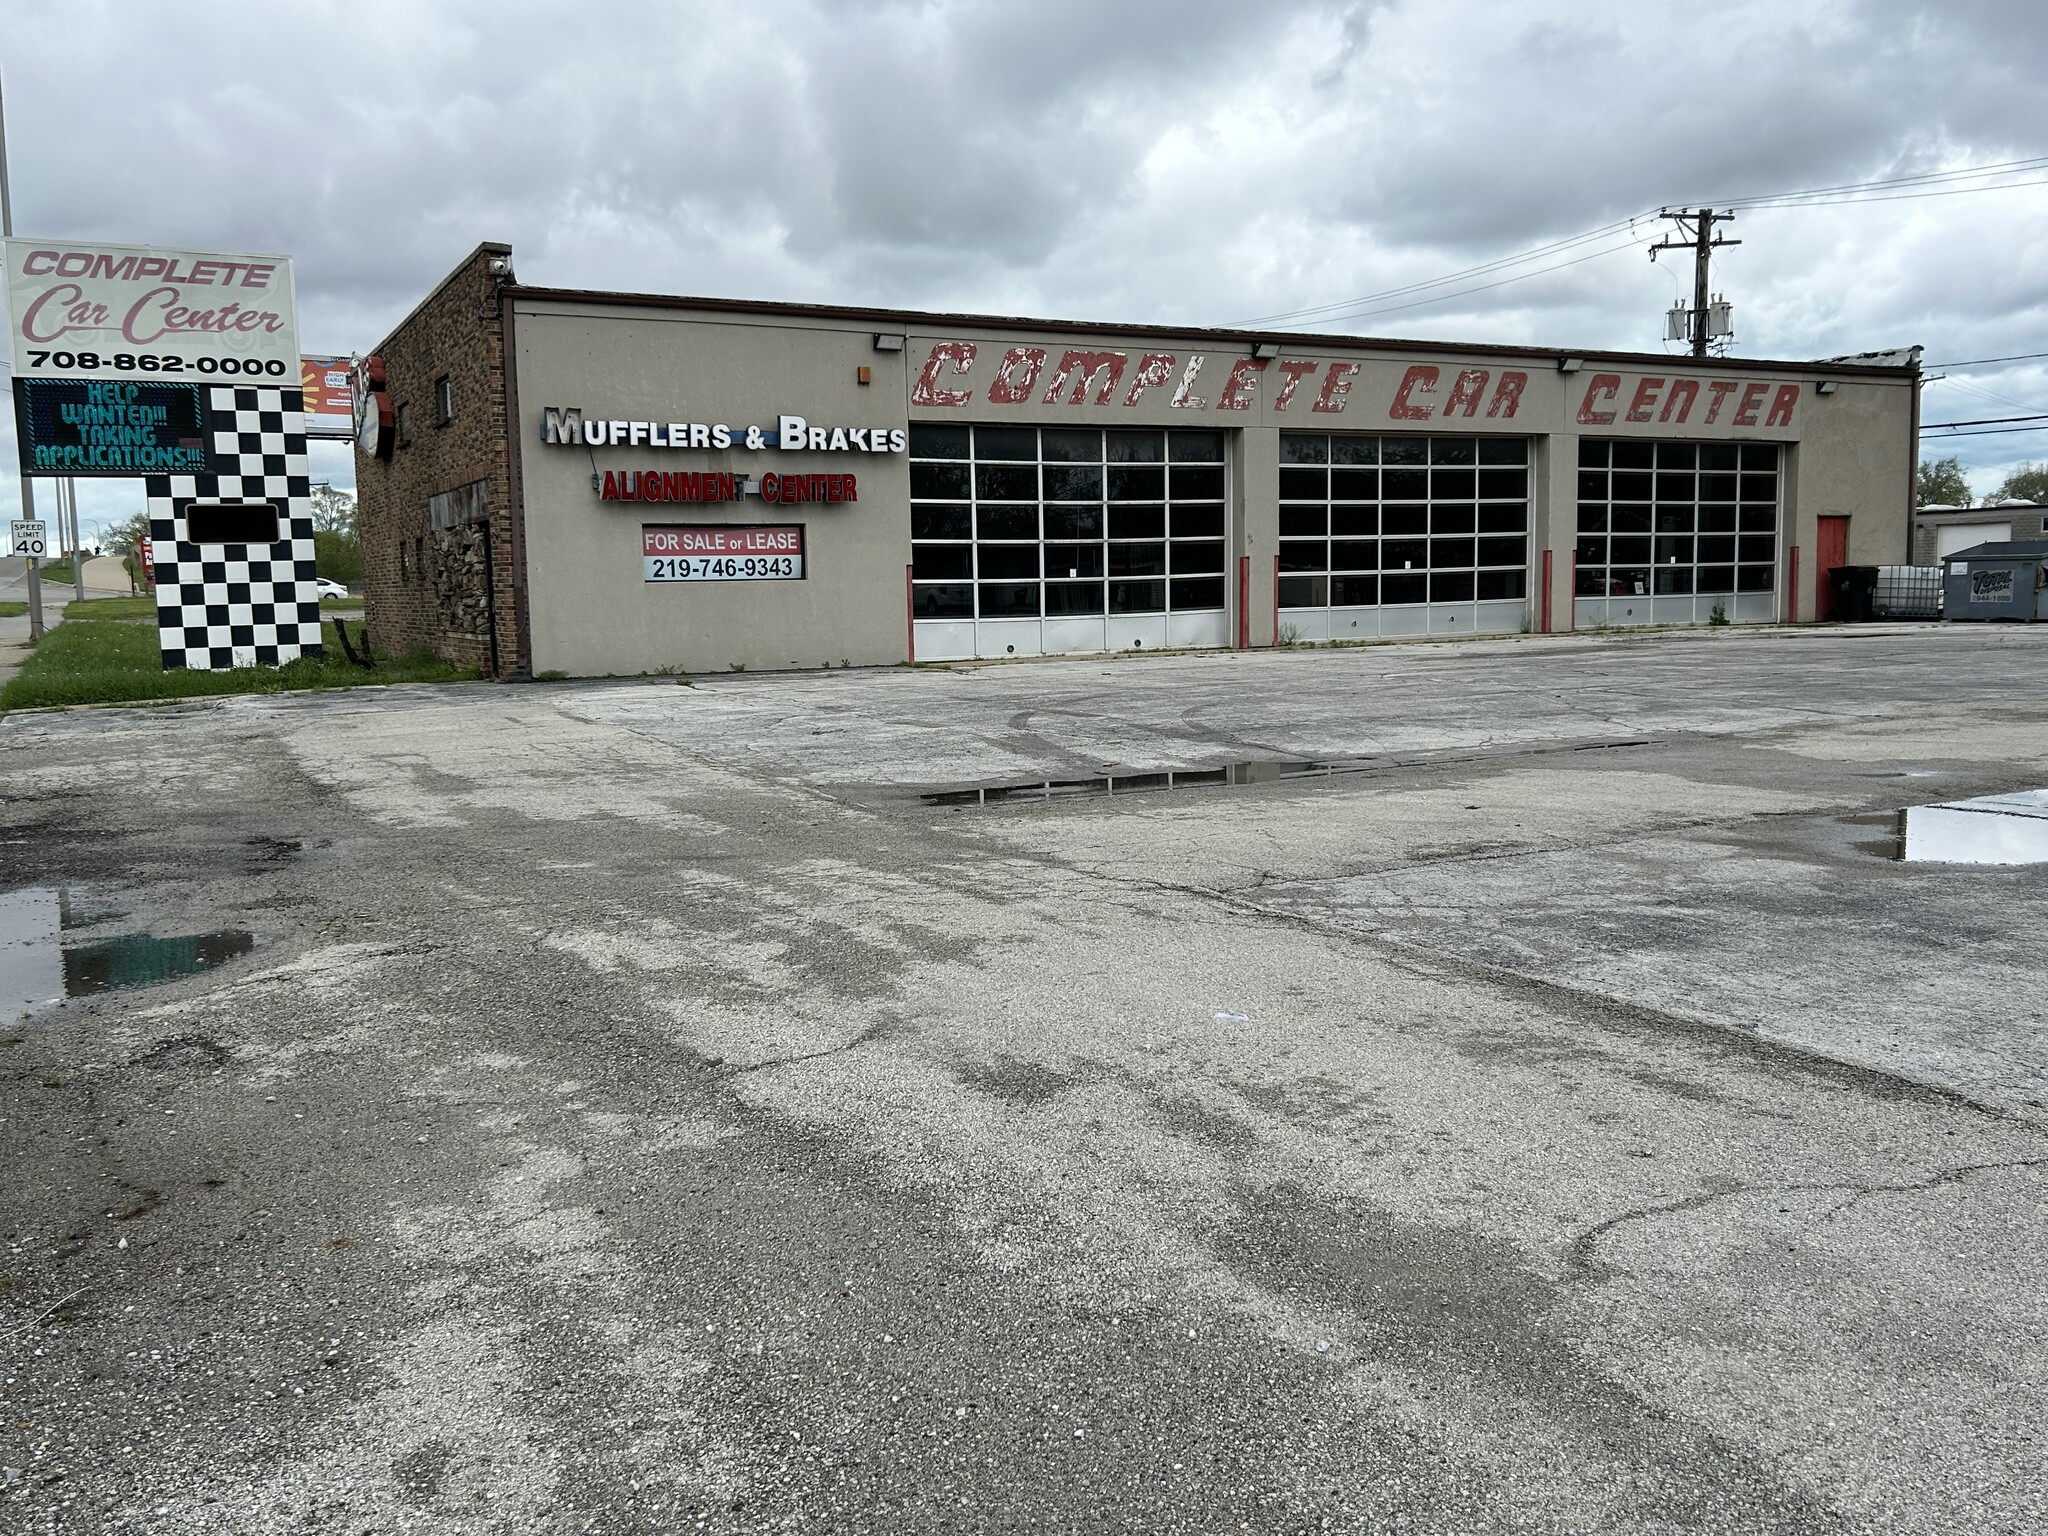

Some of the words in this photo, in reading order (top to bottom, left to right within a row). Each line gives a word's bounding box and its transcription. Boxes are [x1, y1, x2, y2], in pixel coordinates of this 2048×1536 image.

[22, 250, 276, 288] COMPLETE
[22, 284, 122, 343] Car
[122, 287, 284, 345] Center
[27, 350, 286, 376] 708-862-0000
[88, 383, 139, 404] HELP
[911, 342, 1362, 413] COMPLETE
[1389, 365, 1528, 421] CAR
[1576, 374, 1800, 426] CENTER
[61, 404, 168, 426] WANTED!!!
[77, 425, 156, 445] TAKING
[746, 425, 766, 450] &
[35, 445, 200, 467] APPLICATIONS!!!
[601, 470, 749, 502] ALIGNMENT
[759, 472, 858, 503] CENTER
[16, 540, 44, 554] 40
[645, 533, 679, 550] FOR
[683, 533, 726, 550] SALE
[729, 538, 742, 550] or
[746, 533, 797, 549] LEASE
[652, 557, 793, 578] 219-746-9343
[1973, 570, 2012, 595] TOTAL
